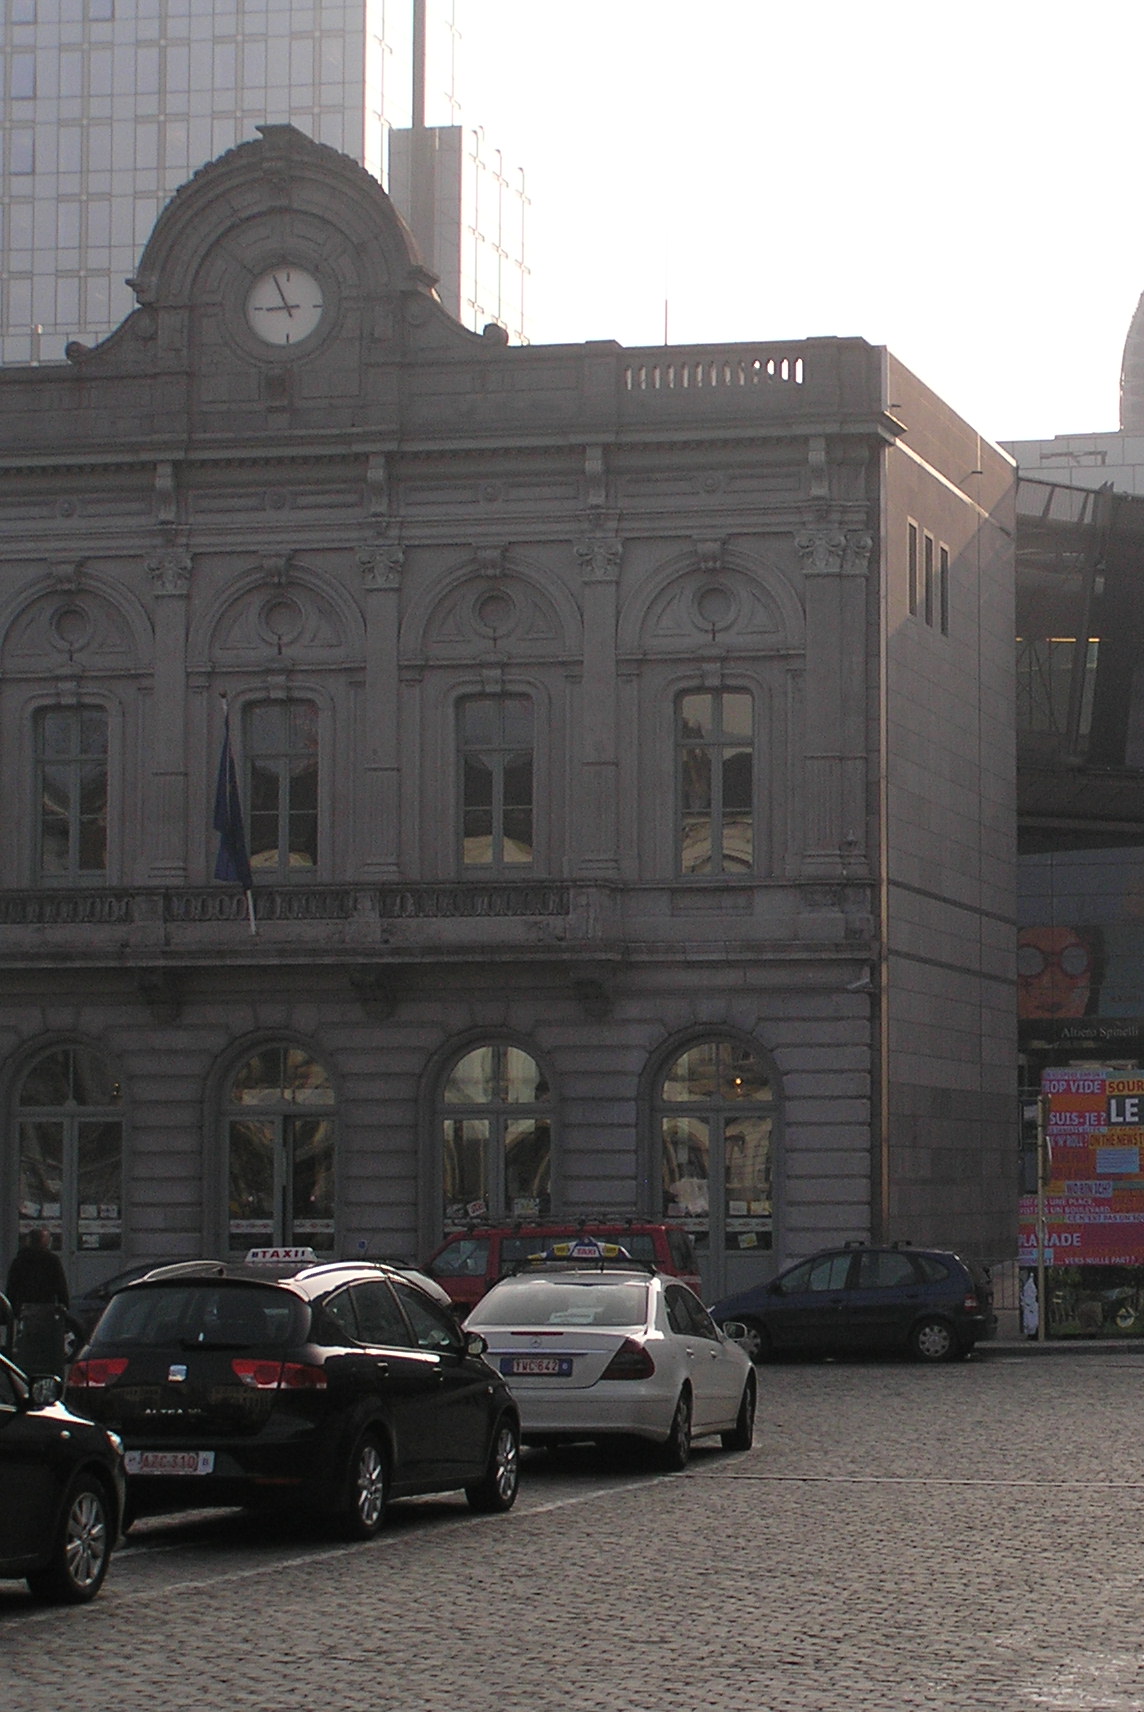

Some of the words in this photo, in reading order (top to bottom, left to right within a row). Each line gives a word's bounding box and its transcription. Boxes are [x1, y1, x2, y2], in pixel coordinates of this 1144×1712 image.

[1069, 1080, 1102, 1093] VIDE
[1110, 1097, 1139, 1123] LE
[1049, 1112, 1098, 1126] SUIS-JE
[261, 1249, 298, 1259] TAXI
[576, 1248, 596, 1256] TAXI
